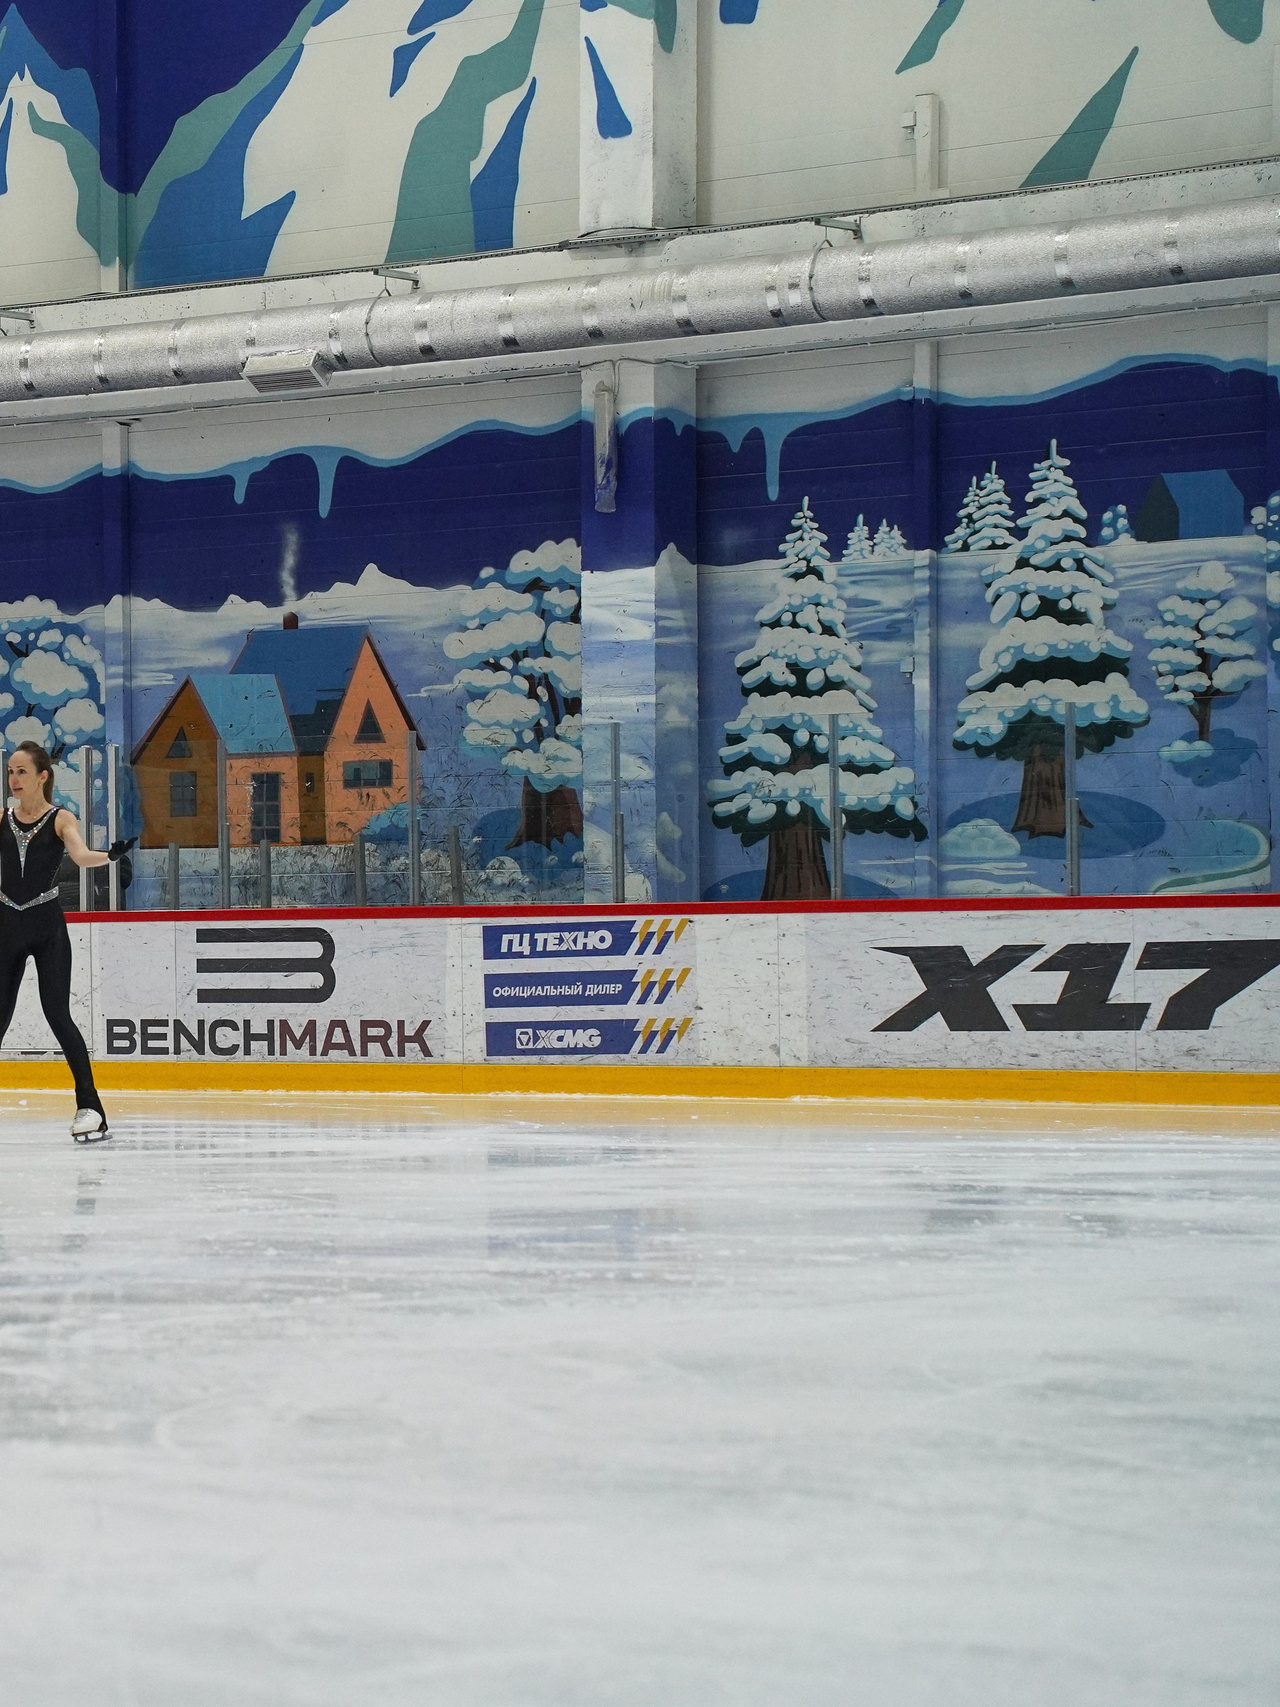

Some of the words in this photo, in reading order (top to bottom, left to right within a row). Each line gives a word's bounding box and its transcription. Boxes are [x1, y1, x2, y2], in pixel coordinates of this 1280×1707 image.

[500, 932, 531, 956] ГЦ
[534, 929, 613, 952] ТЕХНО
[492, 982, 583, 998] ОФИЦИАЛЬНЫЙ
[585, 983, 622, 997] ДИЛЕР
[868, 938, 1280, 1032] X17
[106, 1018, 434, 1058] BENCHMARK
[533, 1028, 602, 1049] XCMG
